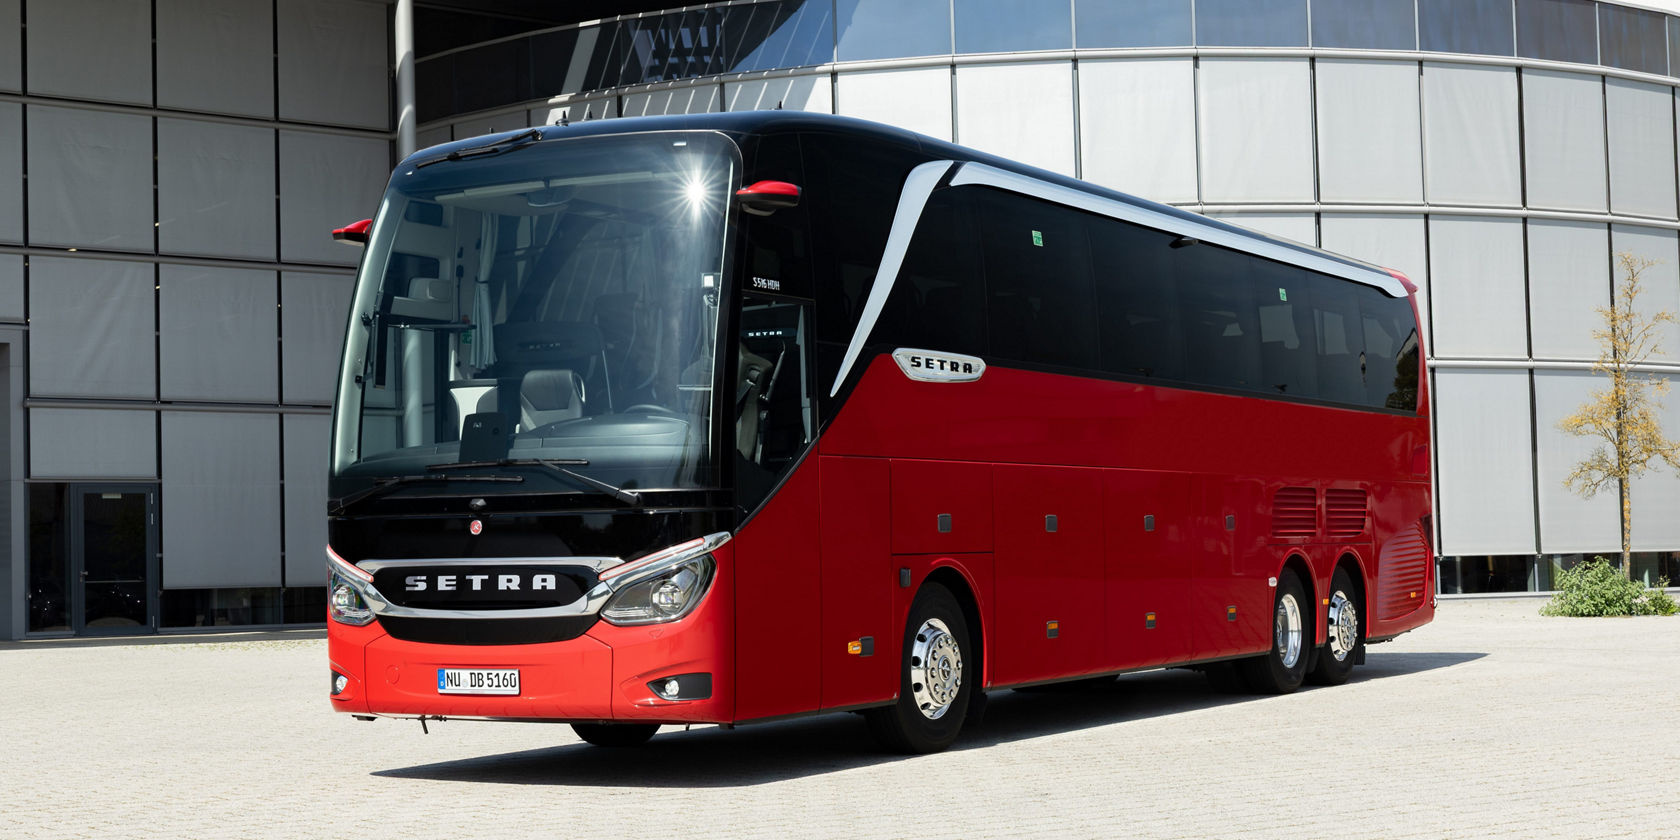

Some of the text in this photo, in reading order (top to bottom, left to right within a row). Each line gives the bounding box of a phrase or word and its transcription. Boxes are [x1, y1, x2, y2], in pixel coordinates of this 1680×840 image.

[910, 356, 973, 374] SETRA
[405, 574, 556, 591] SETRA
[446, 672, 461, 687] NU
[470, 672, 484, 688] DB
[486, 672, 517, 688] 5160
